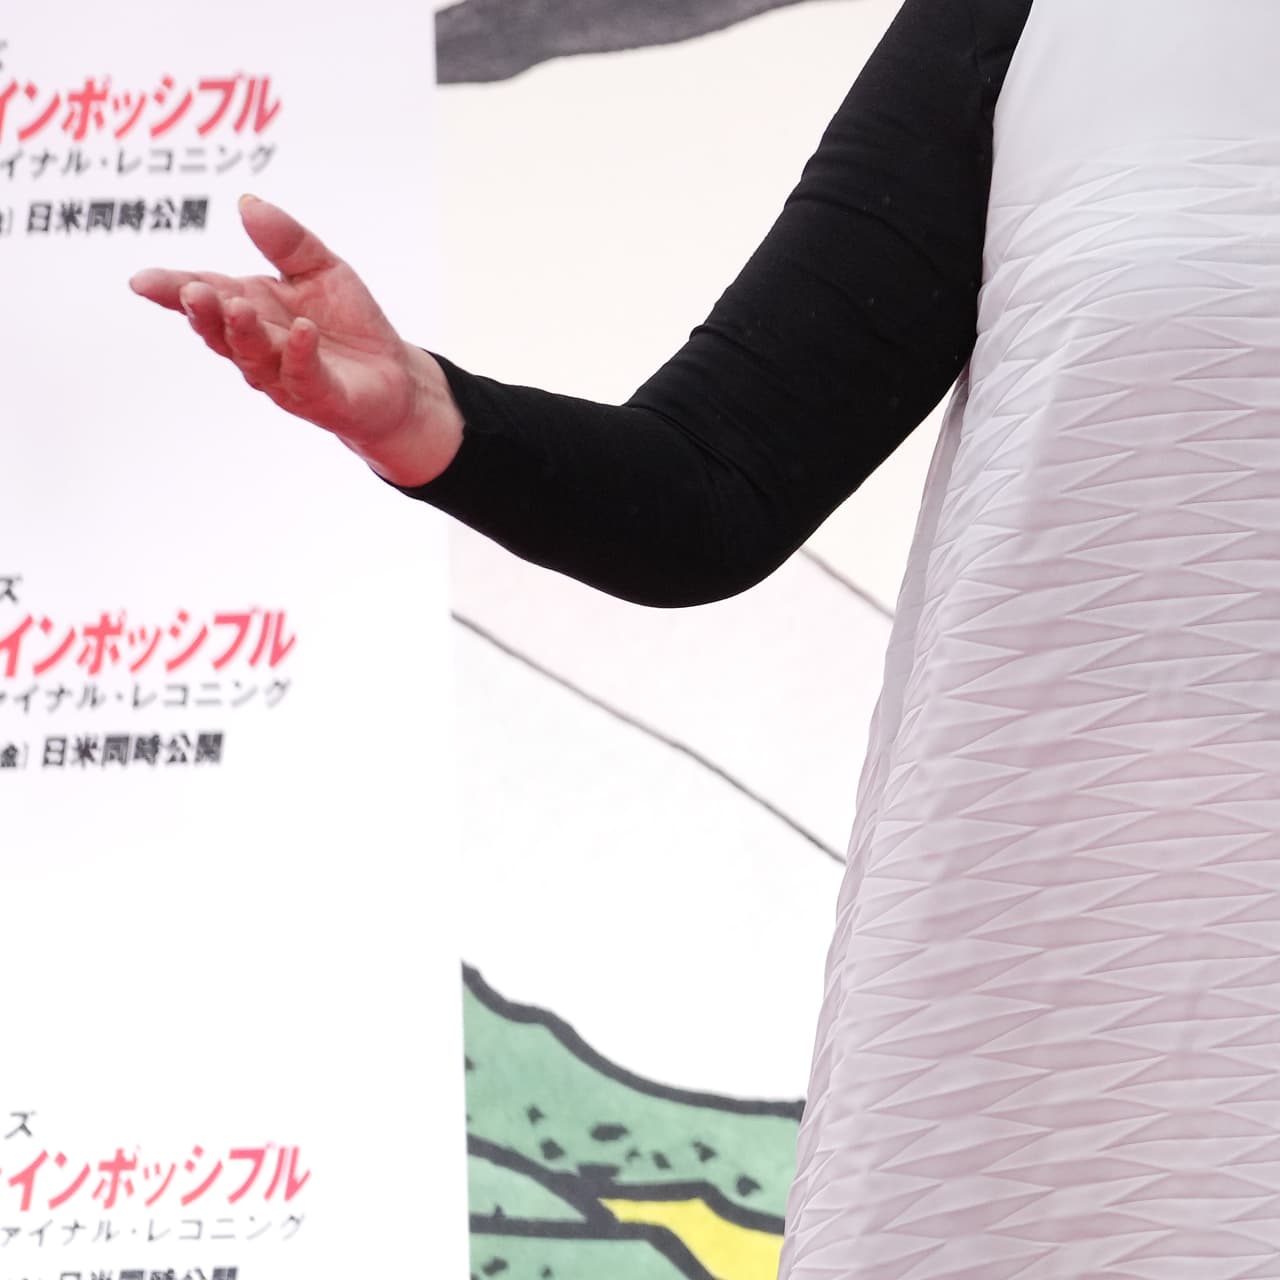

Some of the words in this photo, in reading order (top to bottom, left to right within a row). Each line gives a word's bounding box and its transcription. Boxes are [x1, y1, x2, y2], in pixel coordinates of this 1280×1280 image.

[8, 1143, 311, 1211] インポッシブル
